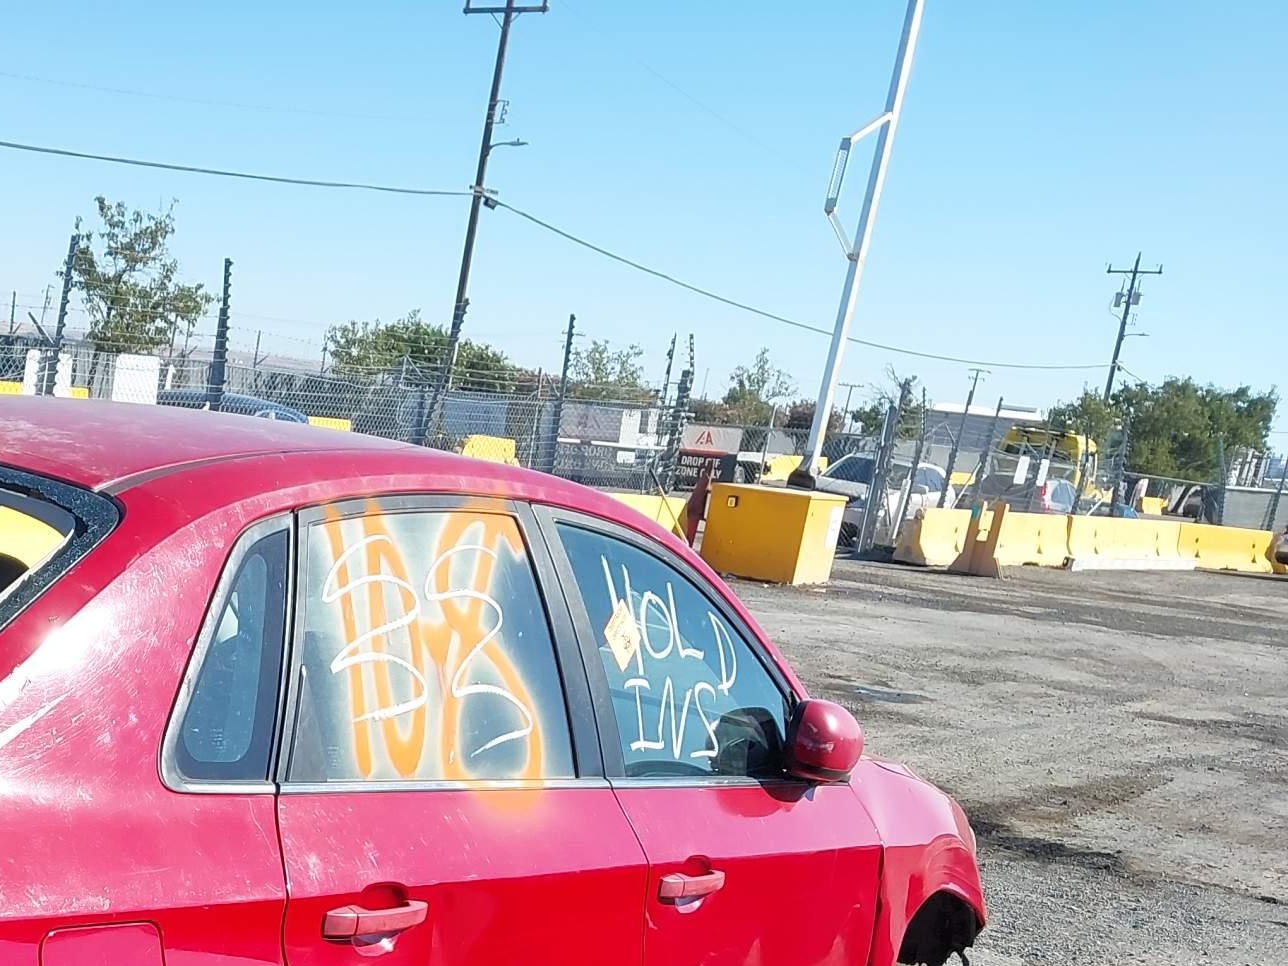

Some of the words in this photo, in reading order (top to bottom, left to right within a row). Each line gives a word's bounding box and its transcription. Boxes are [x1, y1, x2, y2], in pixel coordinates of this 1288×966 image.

[675, 465, 698, 477] ZONE
[681, 456, 705, 467] DROP
[601, 555, 737, 696] HOLD
[623, 676, 721, 760] INS
